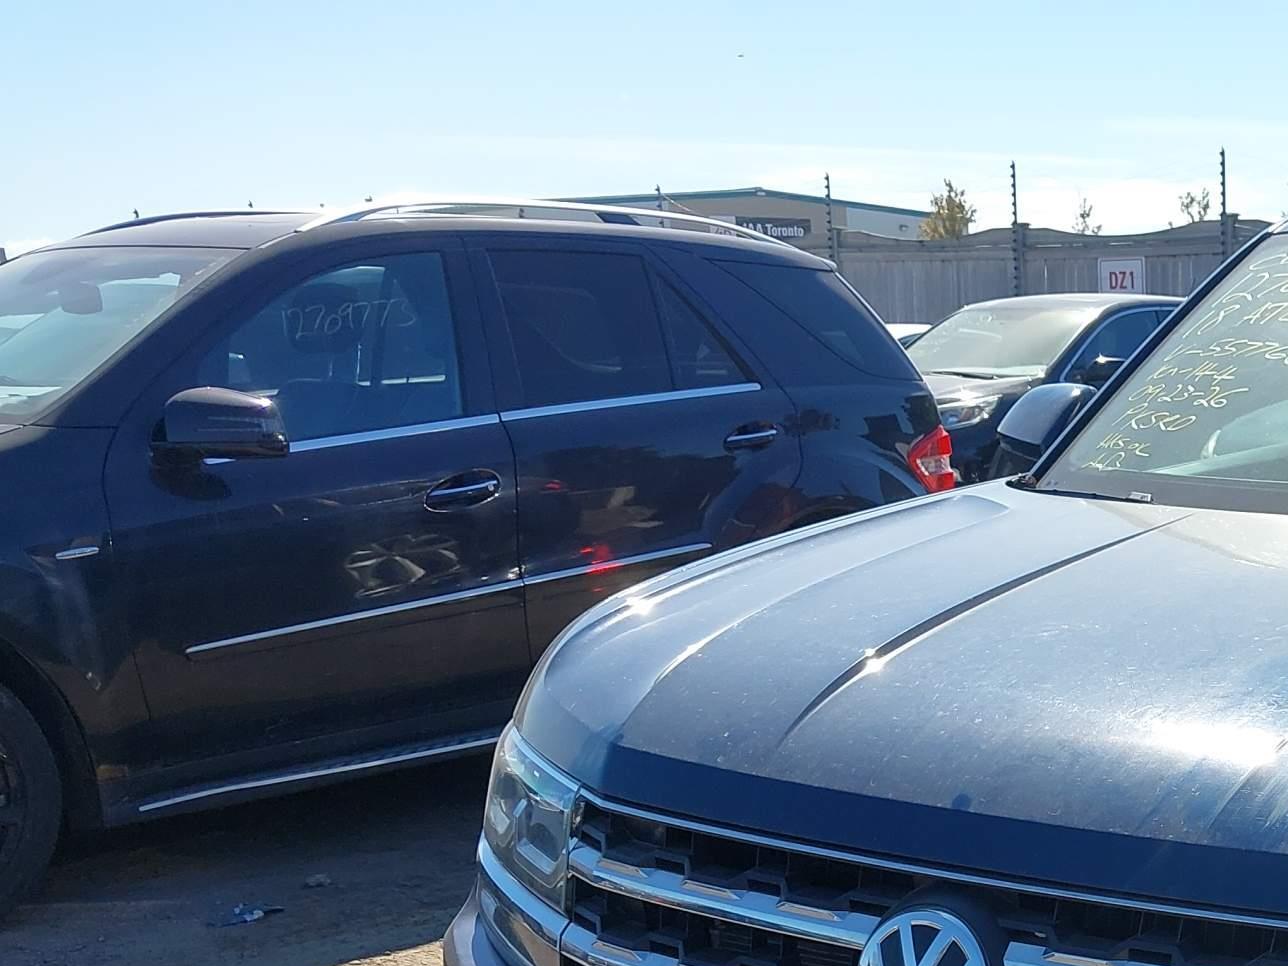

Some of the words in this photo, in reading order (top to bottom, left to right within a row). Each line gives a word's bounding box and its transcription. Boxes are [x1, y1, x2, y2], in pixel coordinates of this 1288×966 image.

[765, 223, 804, 237] Toronto
[1109, 271, 1136, 290] DZ1
[1183, 304, 1240, 338] 18
